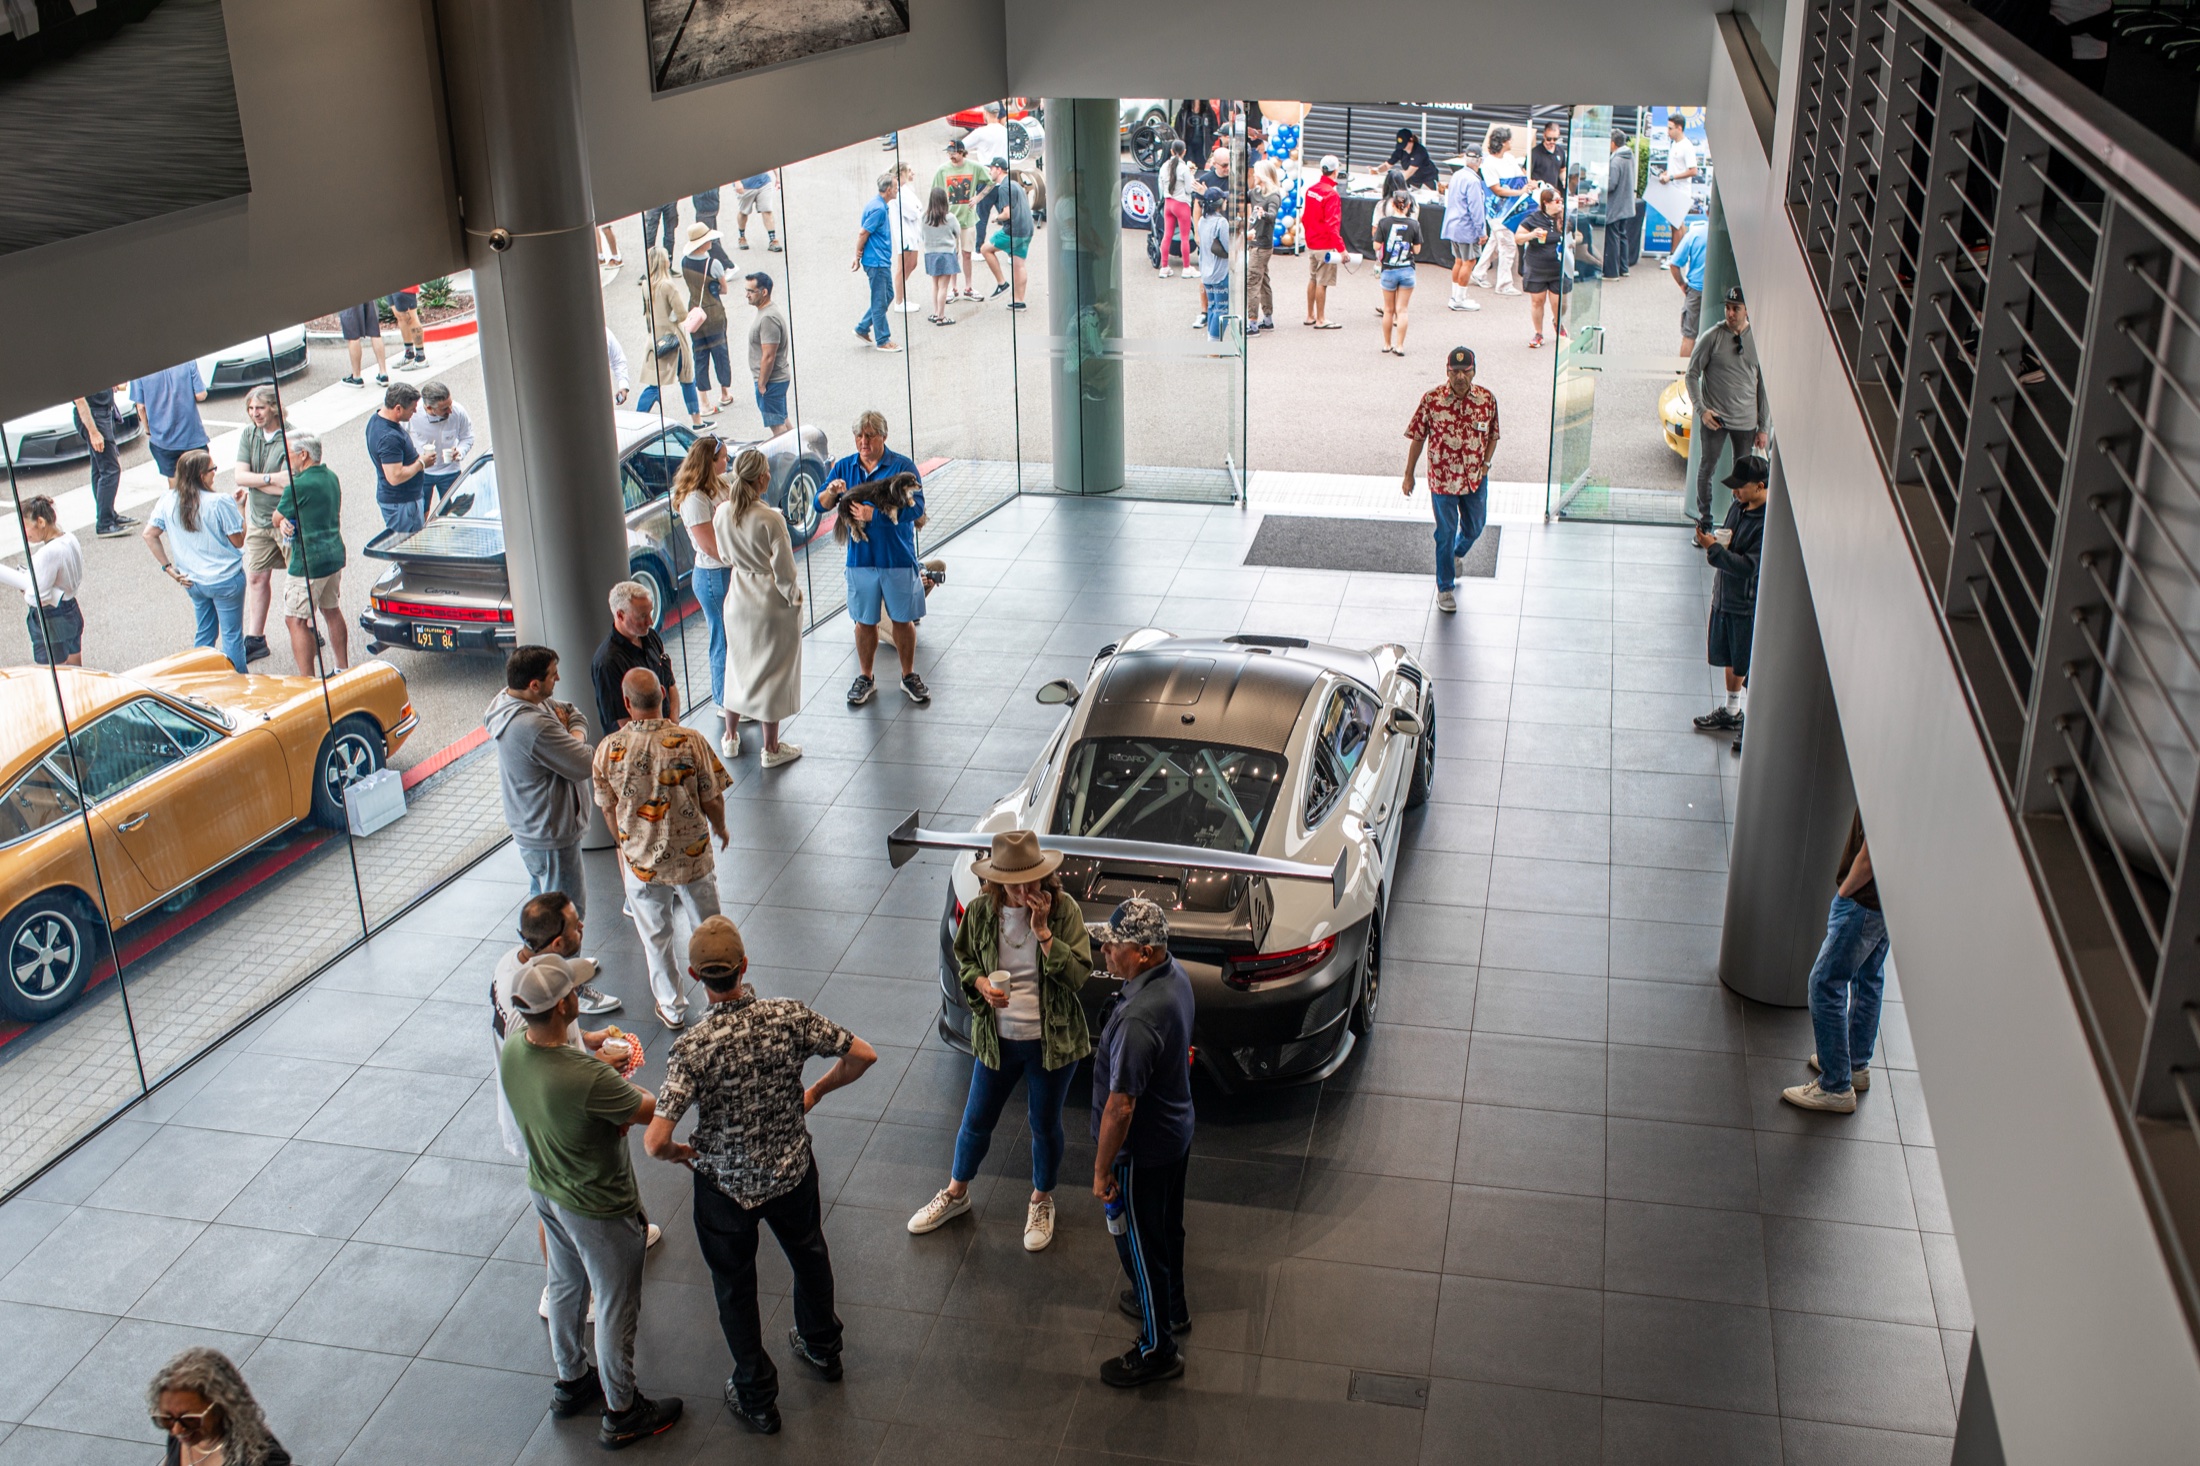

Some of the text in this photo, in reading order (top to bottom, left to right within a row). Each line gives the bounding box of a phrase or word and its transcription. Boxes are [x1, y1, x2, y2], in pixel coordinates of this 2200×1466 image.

[425, 587, 459, 595] Carrera
[398, 605, 486, 619] PORSCHE
[417, 633, 453, 648] 491 84
[1108, 753, 1147, 763] RECARO
